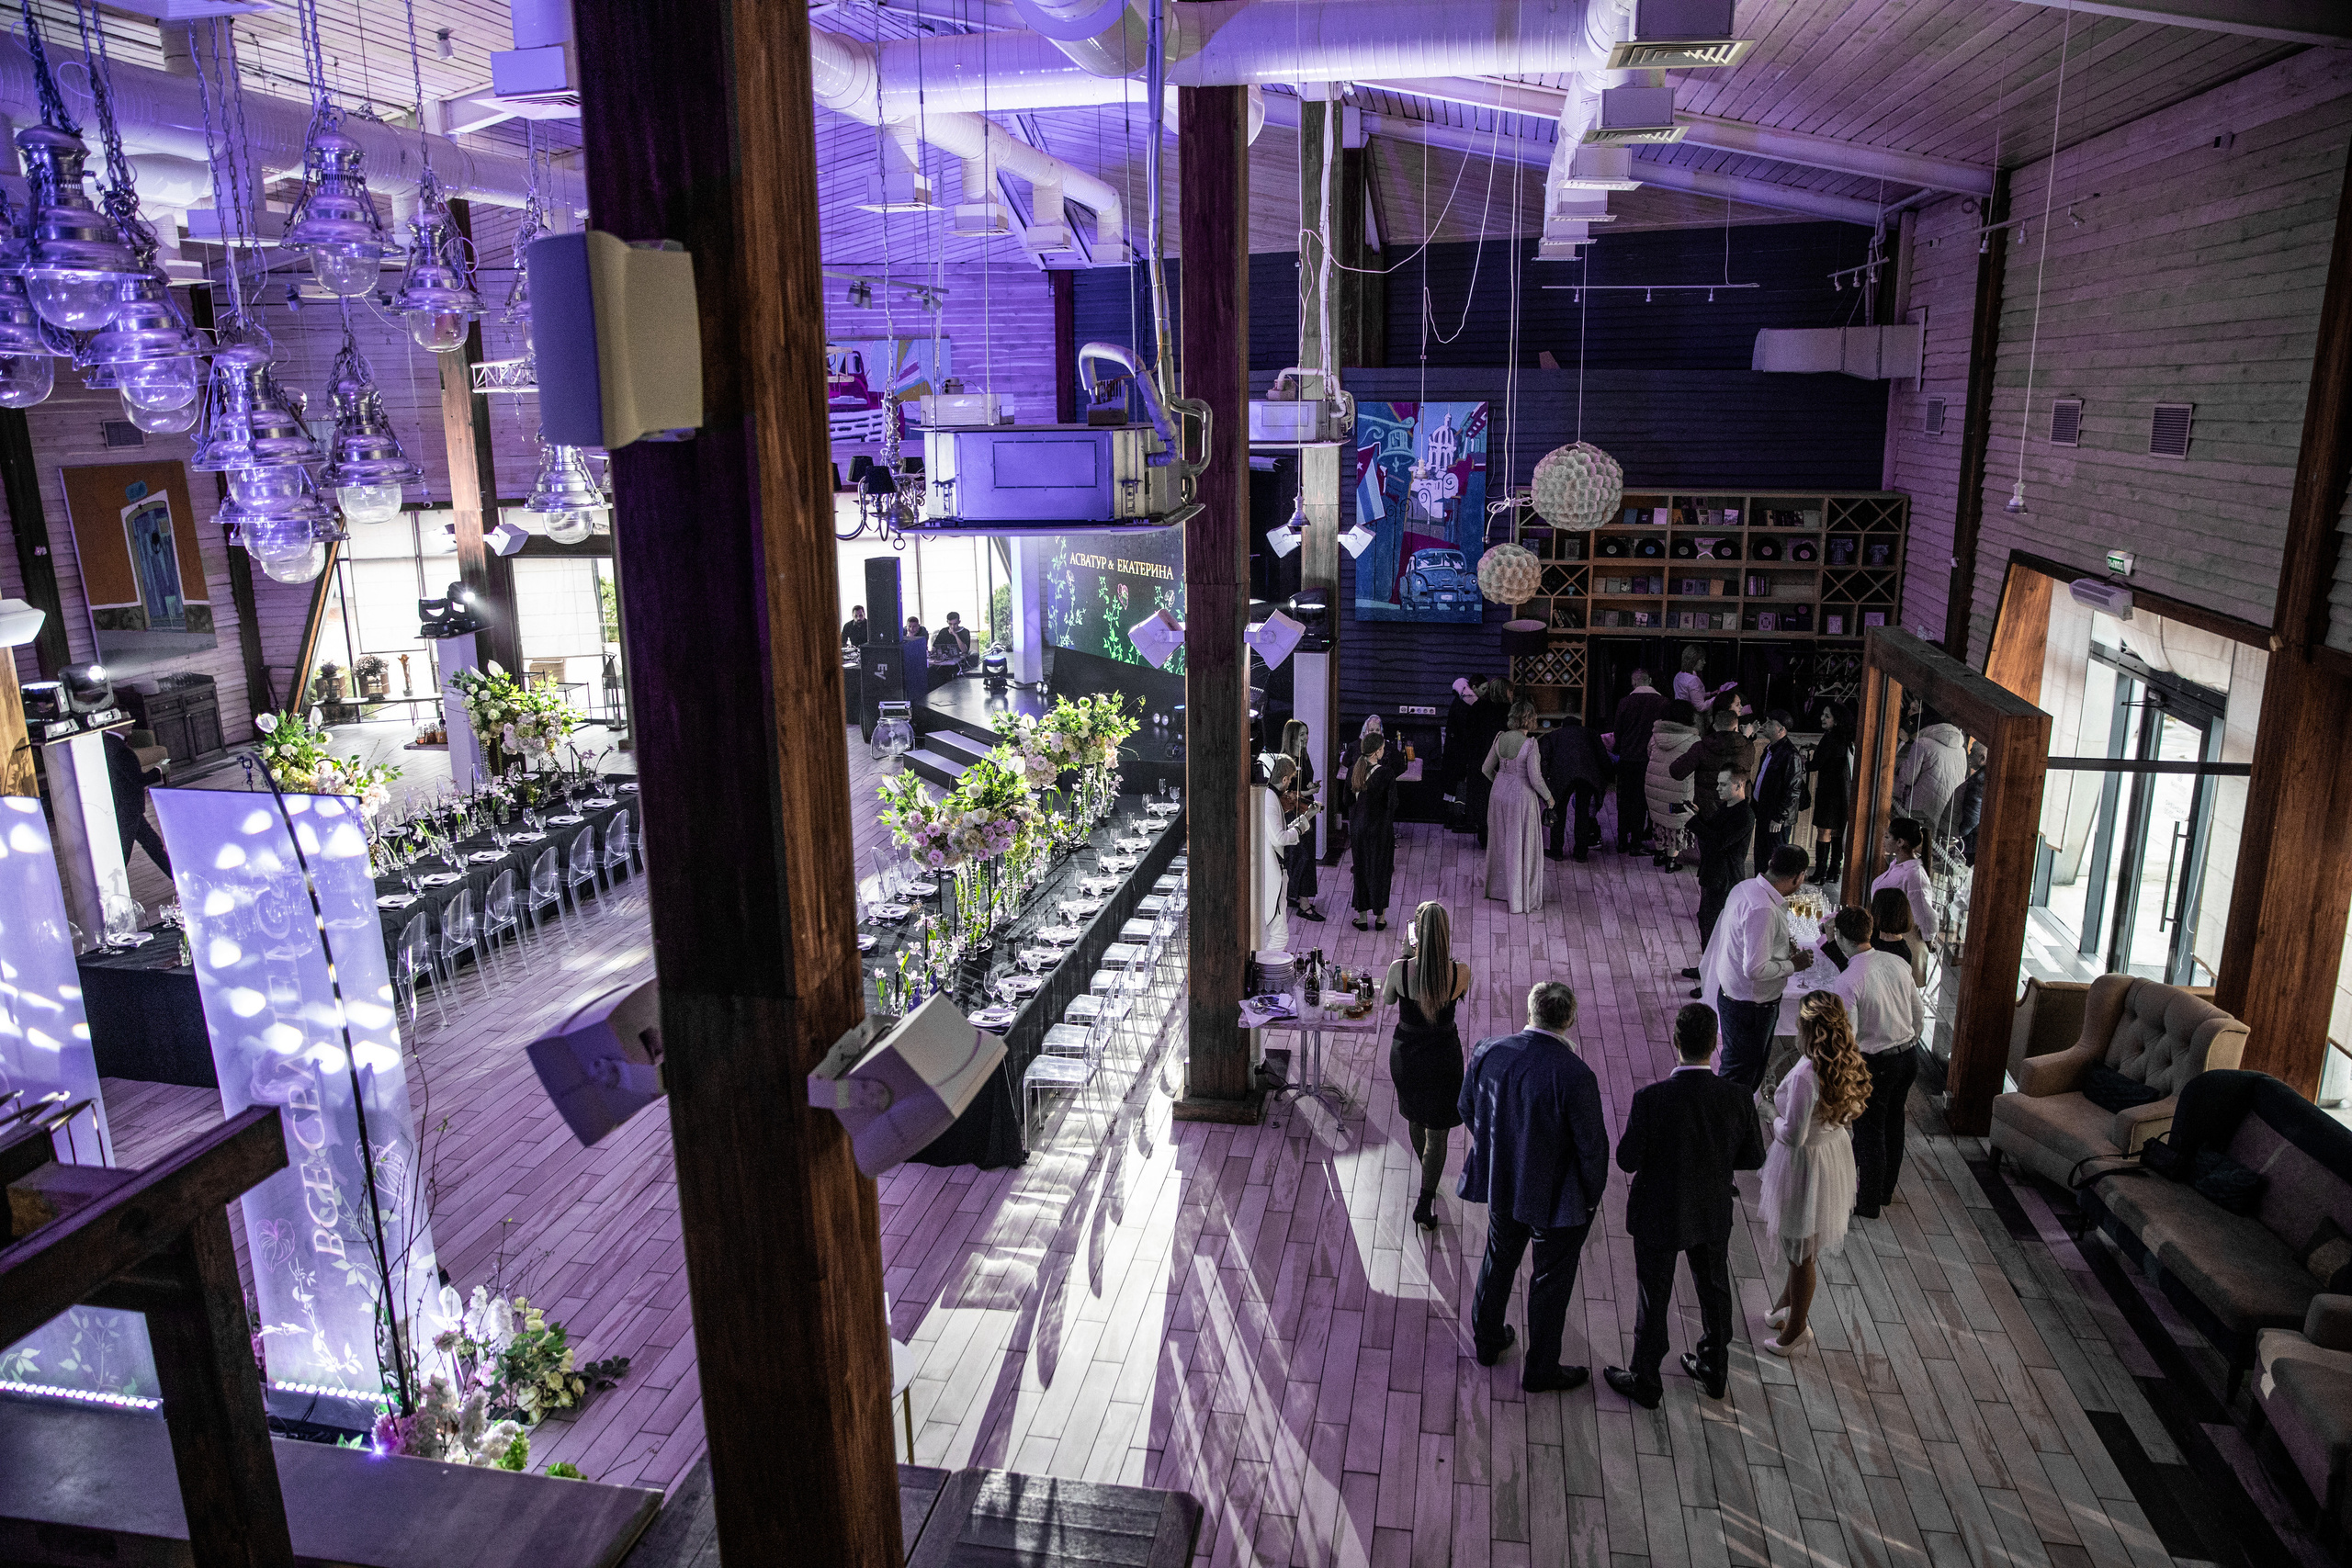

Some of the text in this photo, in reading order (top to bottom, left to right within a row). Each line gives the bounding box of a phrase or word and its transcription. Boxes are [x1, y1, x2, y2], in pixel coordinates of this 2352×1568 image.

[1069, 552, 1174, 580] АСВАТУР & ЕКАТЕРИНА
